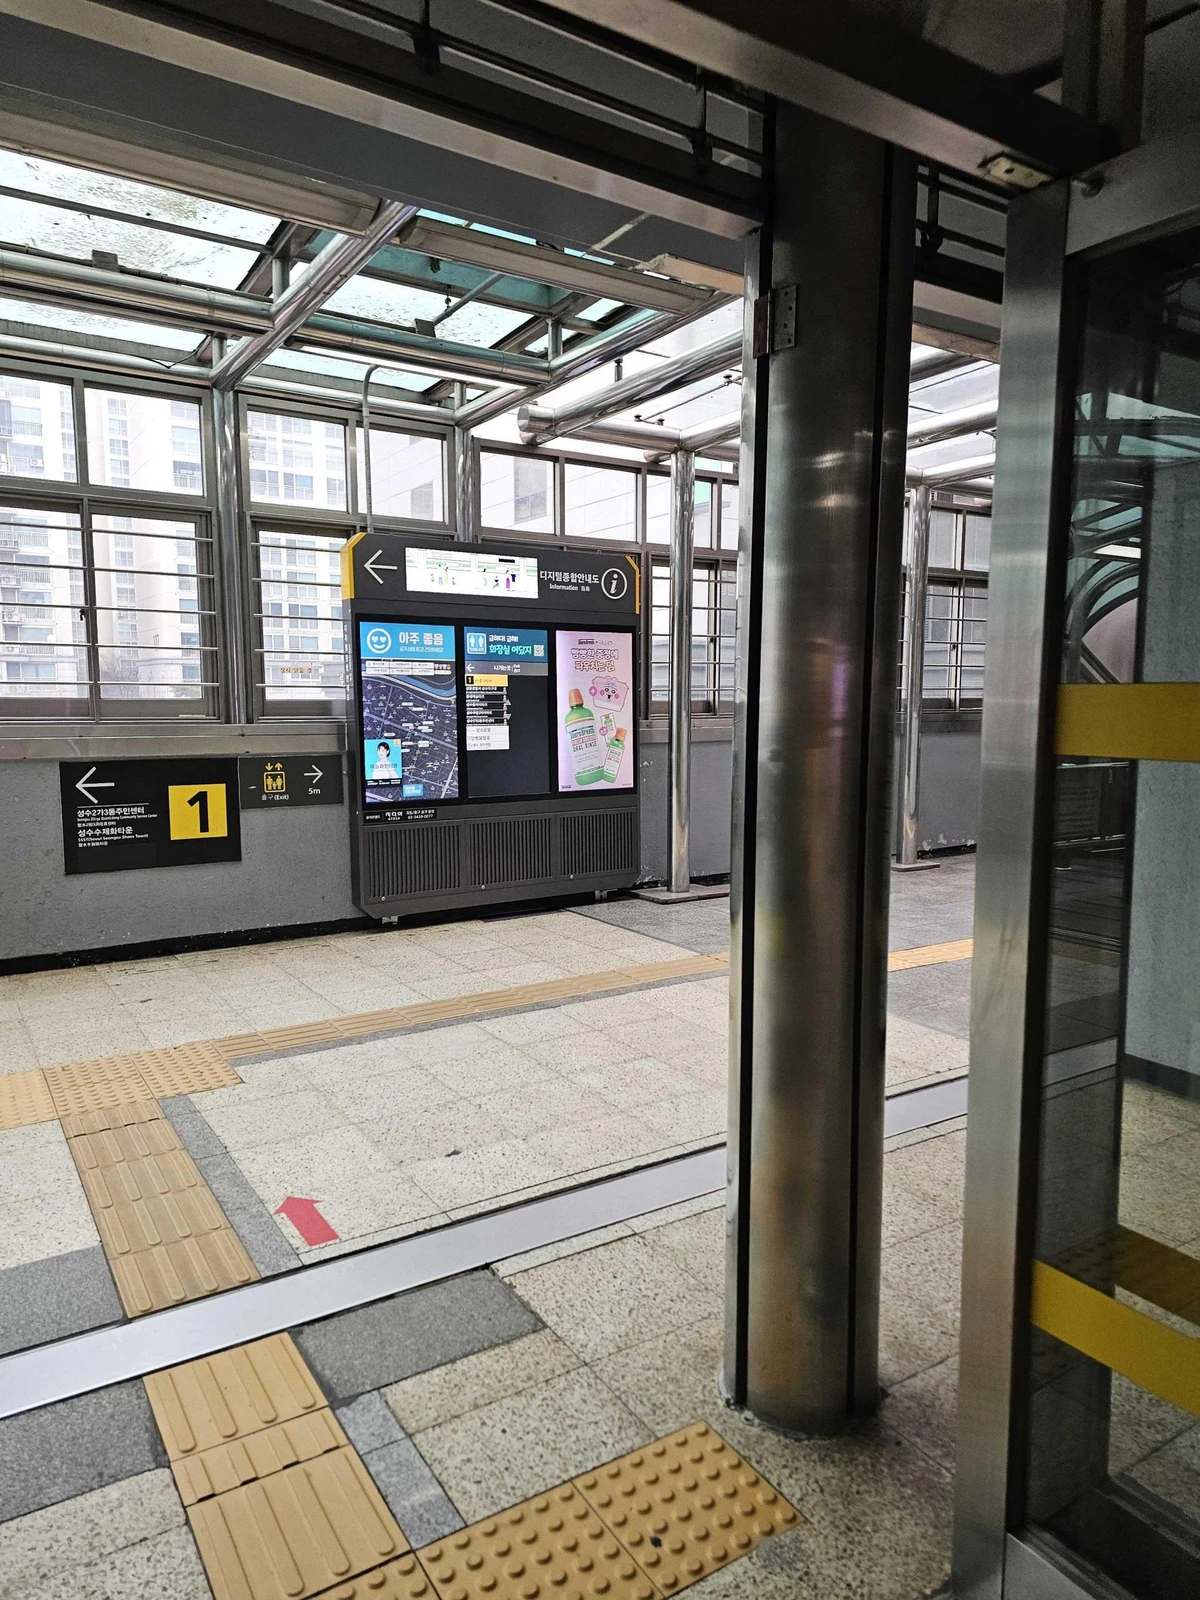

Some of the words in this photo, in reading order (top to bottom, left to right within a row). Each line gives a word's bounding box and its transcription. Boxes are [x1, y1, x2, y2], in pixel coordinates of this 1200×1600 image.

[540, 571, 599, 584] 디지털종합안내도
[549, 583, 578, 591] Information
[399, 632, 419, 645] 아주
[423, 633, 443, 646] 좋음
[489, 644, 510, 655] 화장실
[77, 807, 145, 817] 성수2가3동주민센터
[187, 791, 209, 833] 1
[78, 826, 133, 837] 성수수제화타운
